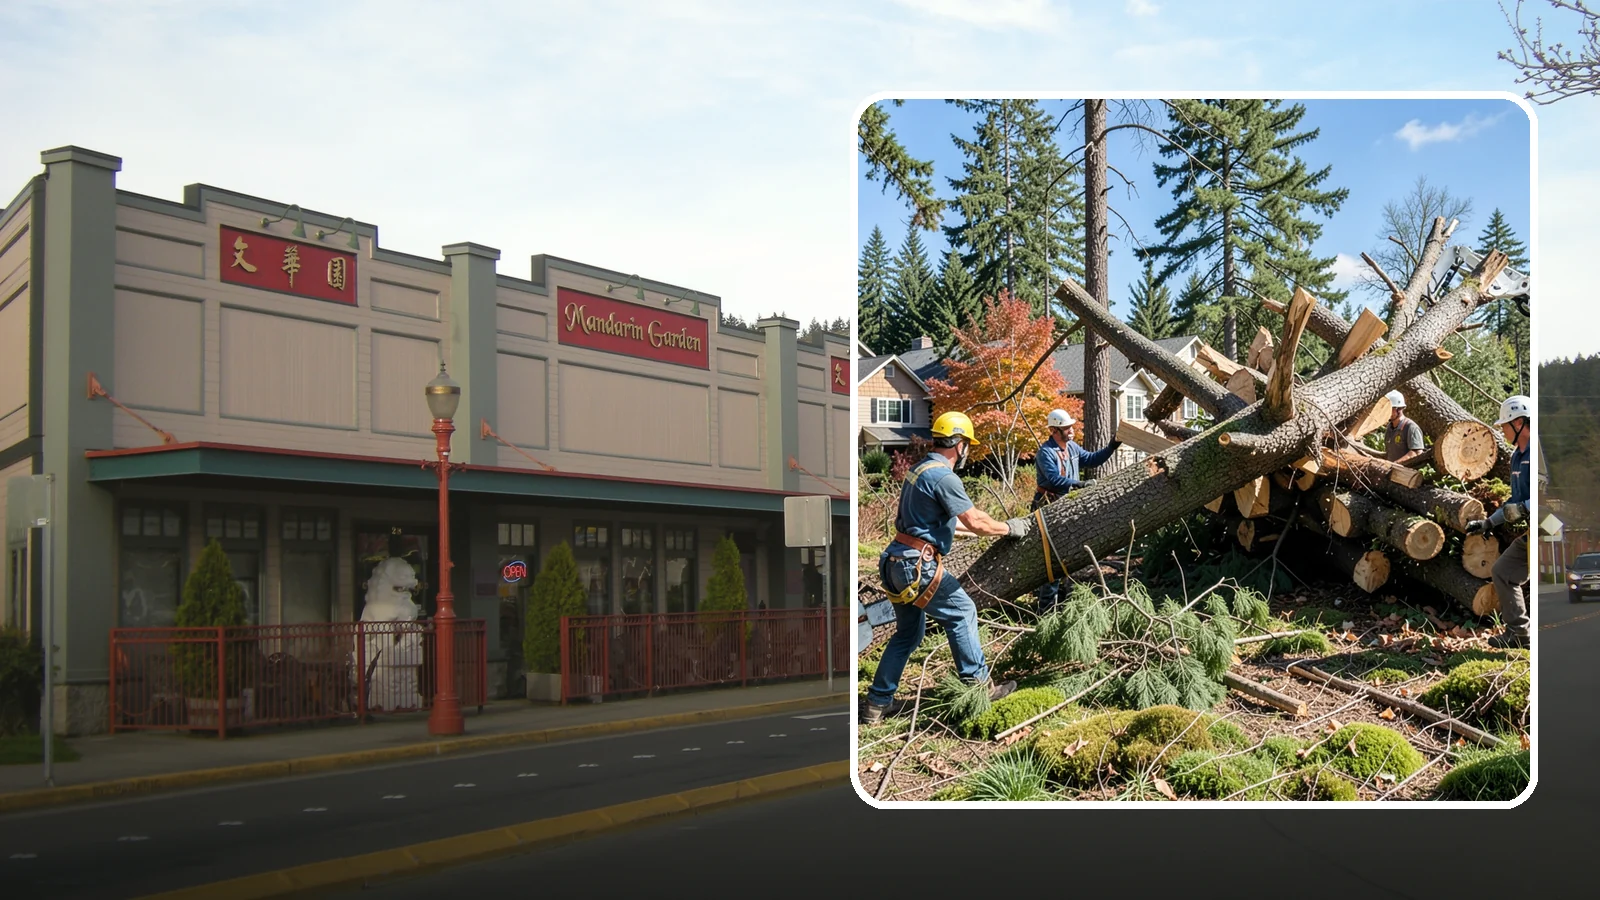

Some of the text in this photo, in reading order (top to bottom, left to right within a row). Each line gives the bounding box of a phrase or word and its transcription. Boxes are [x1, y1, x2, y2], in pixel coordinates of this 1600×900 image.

[230, 235, 347, 291] 文華園
[564, 302, 702, 352] Mandarin Garden
[835, 363, 846, 386] 文
[503, 565, 527, 578] OPEN
